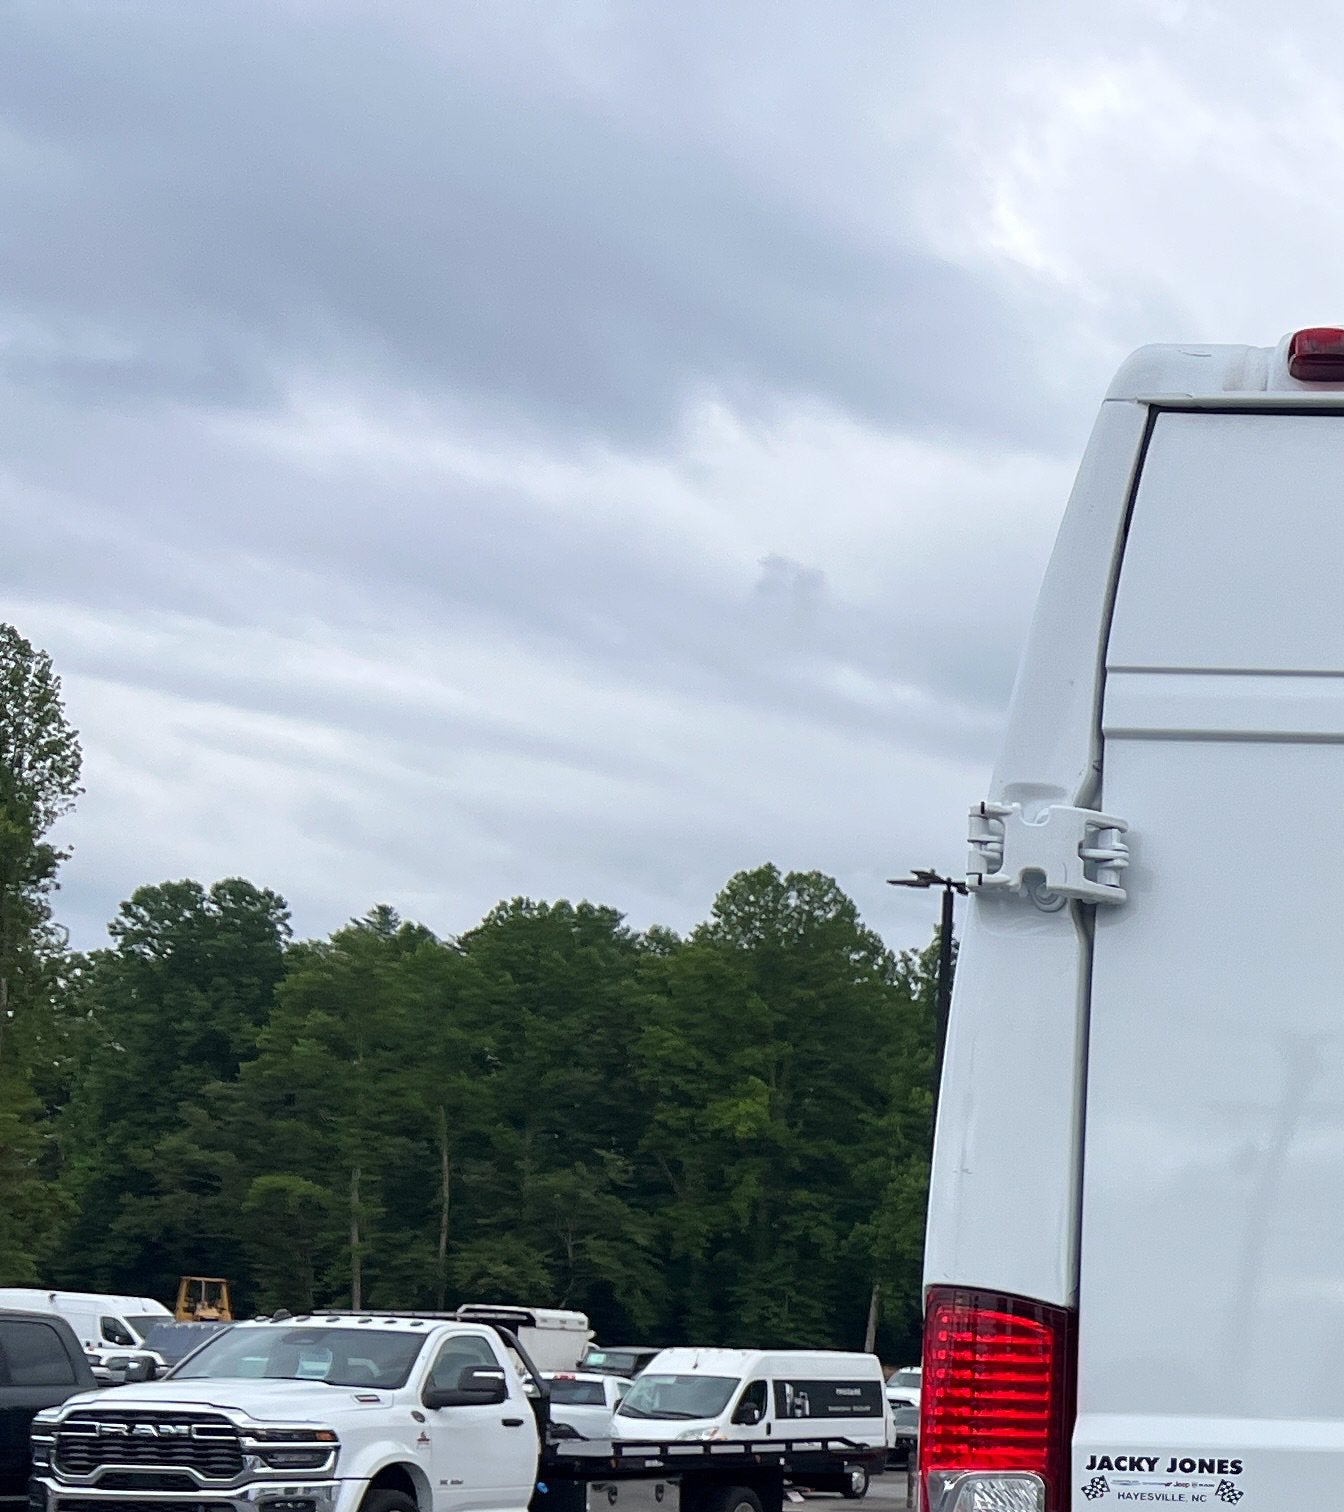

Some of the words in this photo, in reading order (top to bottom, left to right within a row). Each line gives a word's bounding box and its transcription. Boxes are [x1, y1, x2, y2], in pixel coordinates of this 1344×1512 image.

[98, 1424, 192, 1438] RAM
[1085, 1454, 1161, 1473] JACKY
[1166, 1456, 1244, 1475] JONES
[1117, 1491, 1189, 1503] HAYESVILLE,
[1191, 1494, 1207, 1503] NC
